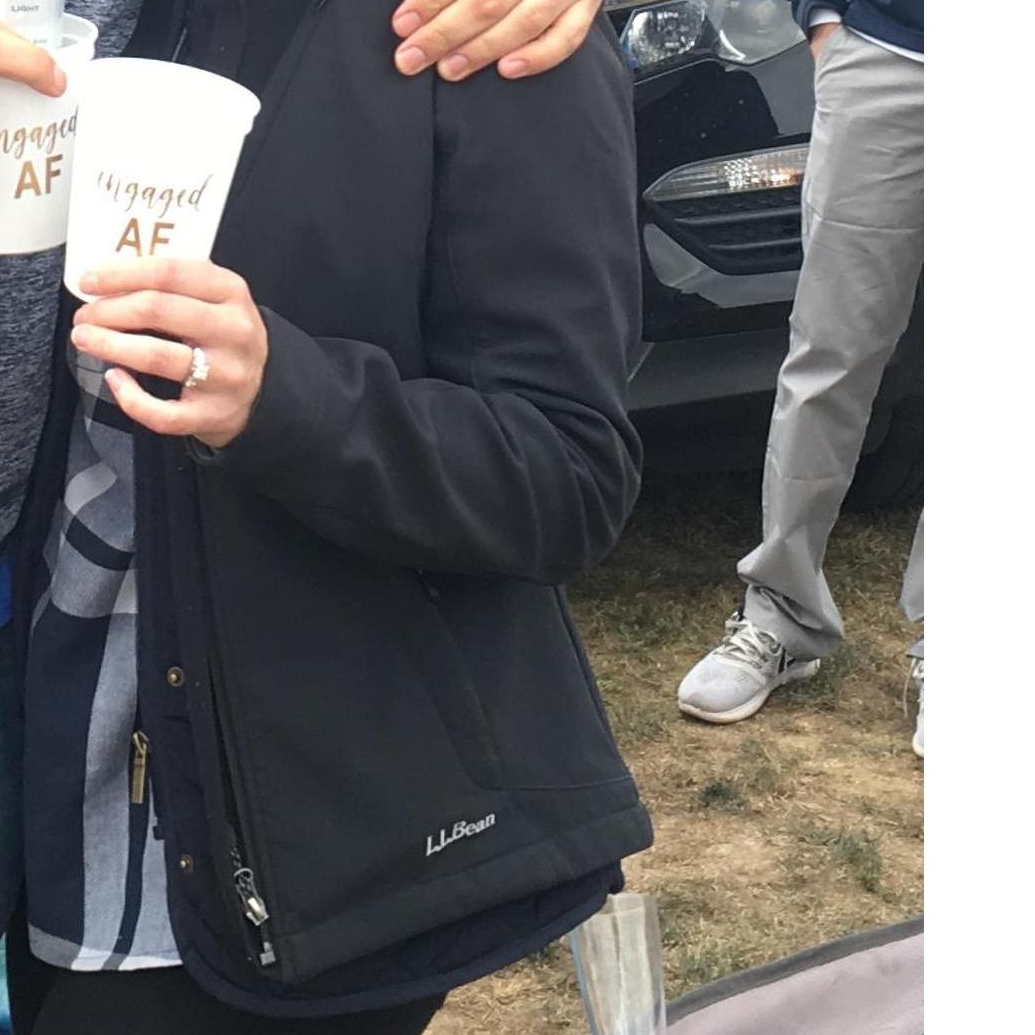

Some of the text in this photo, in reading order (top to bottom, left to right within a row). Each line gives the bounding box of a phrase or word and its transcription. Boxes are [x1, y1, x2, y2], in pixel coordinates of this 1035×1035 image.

[13, 154, 63, 199] AF
[115, 217, 175, 257] AF
[425, 813, 496, 856] L.L.Bean
